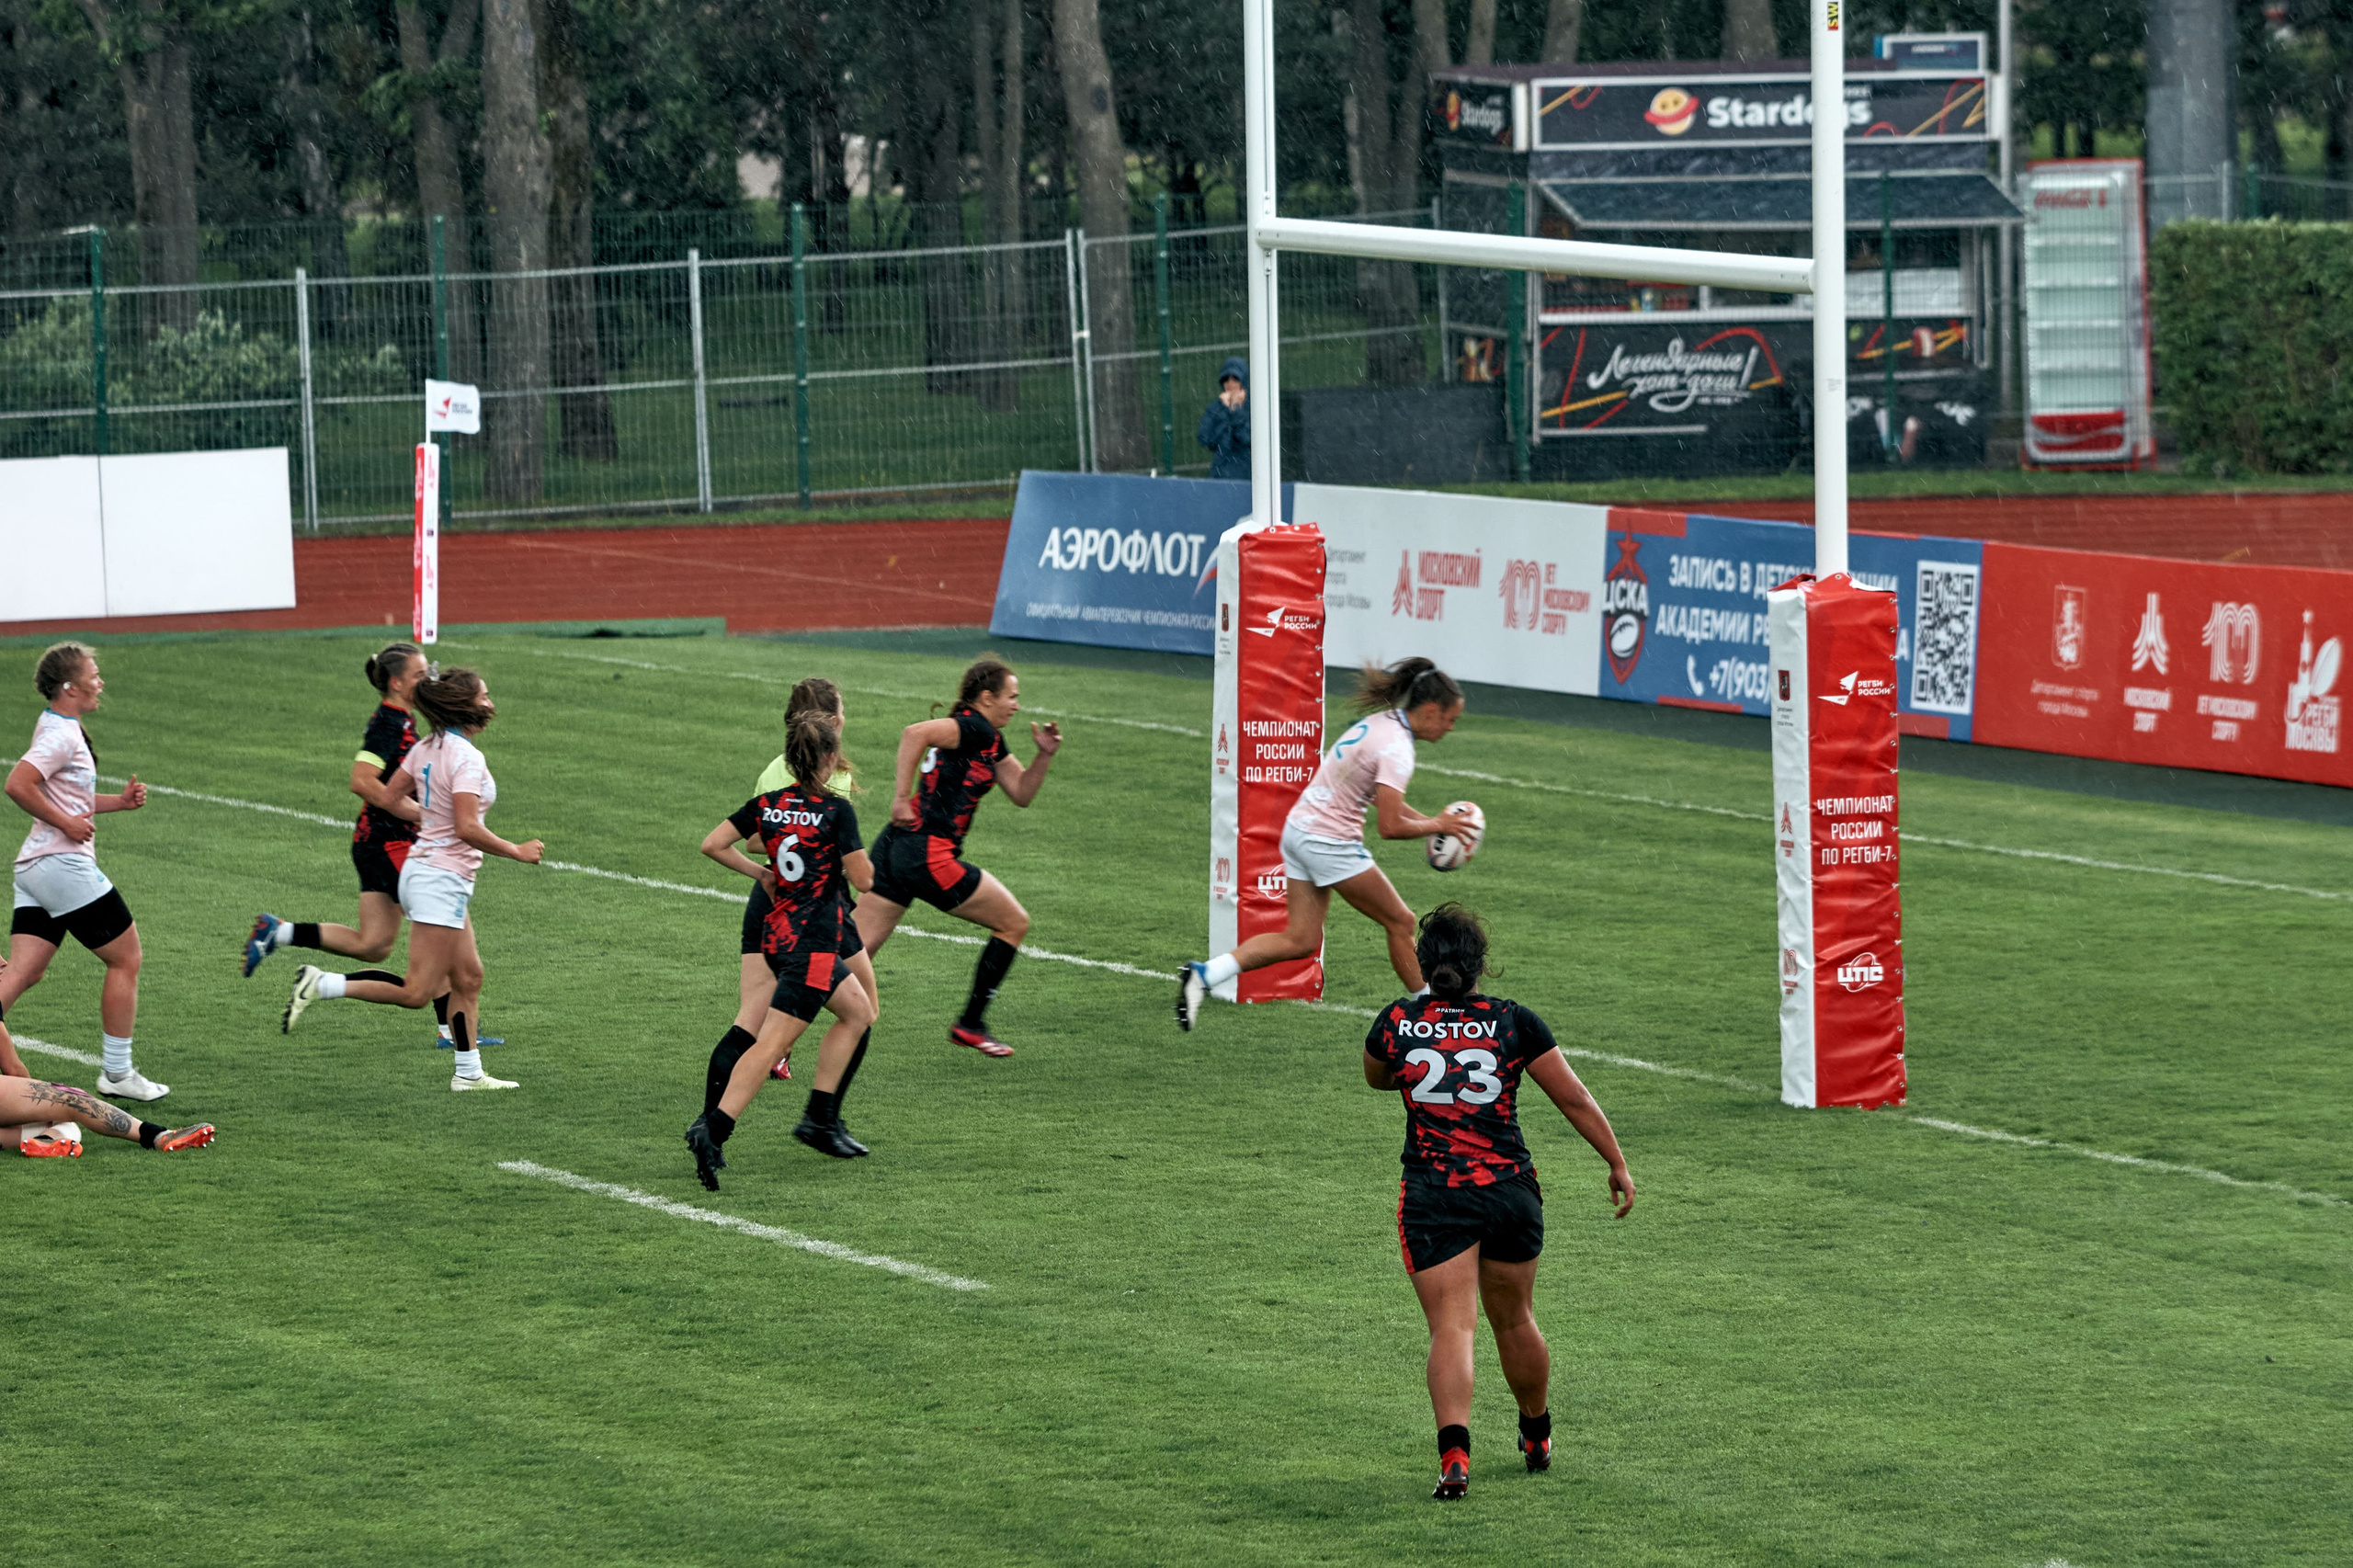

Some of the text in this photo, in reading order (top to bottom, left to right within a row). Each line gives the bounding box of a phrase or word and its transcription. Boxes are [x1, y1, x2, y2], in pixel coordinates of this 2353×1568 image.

[1707, 94, 1872, 130] Stards
[1039, 527, 1207, 577] АЭРОФЛОТ
[1668, 554, 1737, 592] ЗАПИСЬ
[1740, 562, 1752, 594] В
[1602, 579, 1649, 618] ЦСКА
[1284, 622, 1317, 631] РОССИИ
[1655, 603, 1749, 645] АКАДЕМИИ
[1858, 680, 1883, 688] РЕГБИ
[1858, 687, 1891, 697] РОССИИ
[1243, 721, 1317, 738] ЧЕМПИОНАТ
[1256, 743, 1304, 760] РОССИИ
[1245, 766, 1314, 783] ПО РЕГБИ-7
[1816, 795, 1893, 816] ЧЕМПИОНАТ
[762, 807, 824, 826] ROSTOV
[1831, 821, 1883, 840] РОССИИ
[777, 834, 805, 882] 6
[1821, 846, 1892, 866] ПО РЕГБИ-7
[1257, 875, 1287, 891] ЦП
[1398, 1019, 1497, 1039] ROSTOV
[1404, 1048, 1503, 1105] 23
